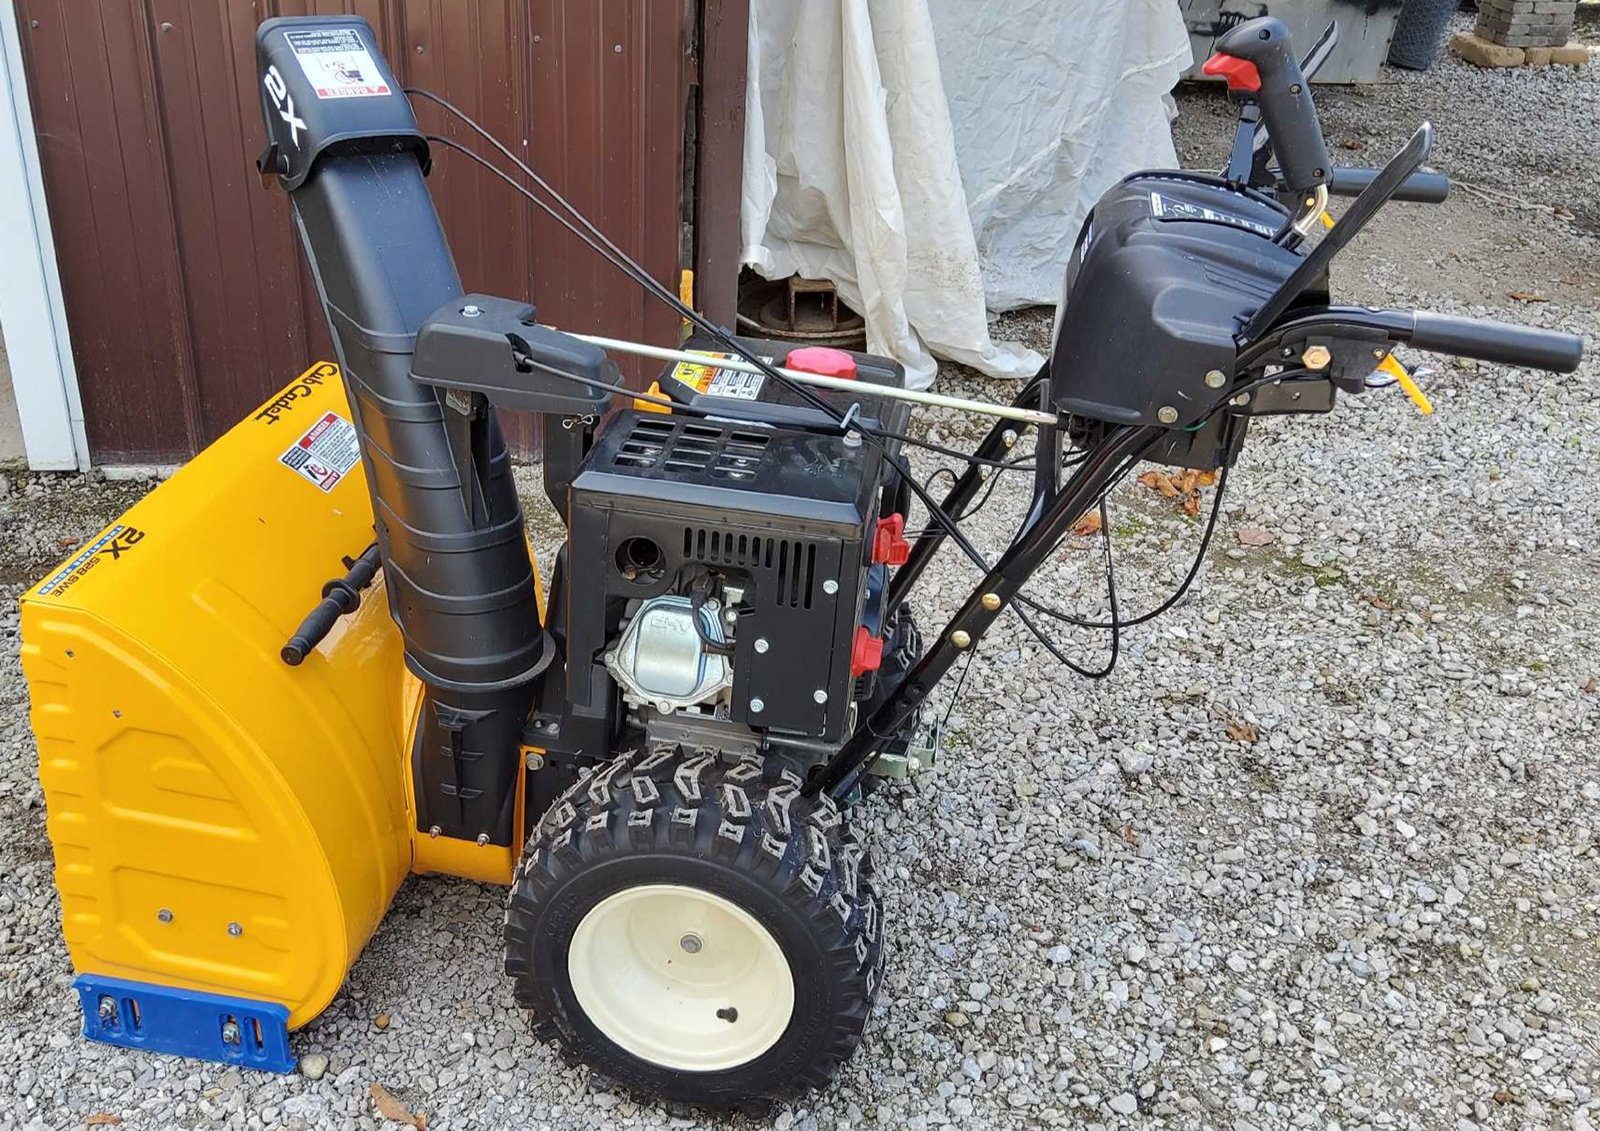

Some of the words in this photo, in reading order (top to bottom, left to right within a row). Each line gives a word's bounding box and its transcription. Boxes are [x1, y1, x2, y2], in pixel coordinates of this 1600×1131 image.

[327, 86, 369, 97] DANGER
[264, 65, 308, 148] 2X
[301, 364, 338, 385] Cub
[254, 384, 312, 425] Cadet
[98, 526, 145, 560] 2X
[50, 574, 79, 598] SWE
